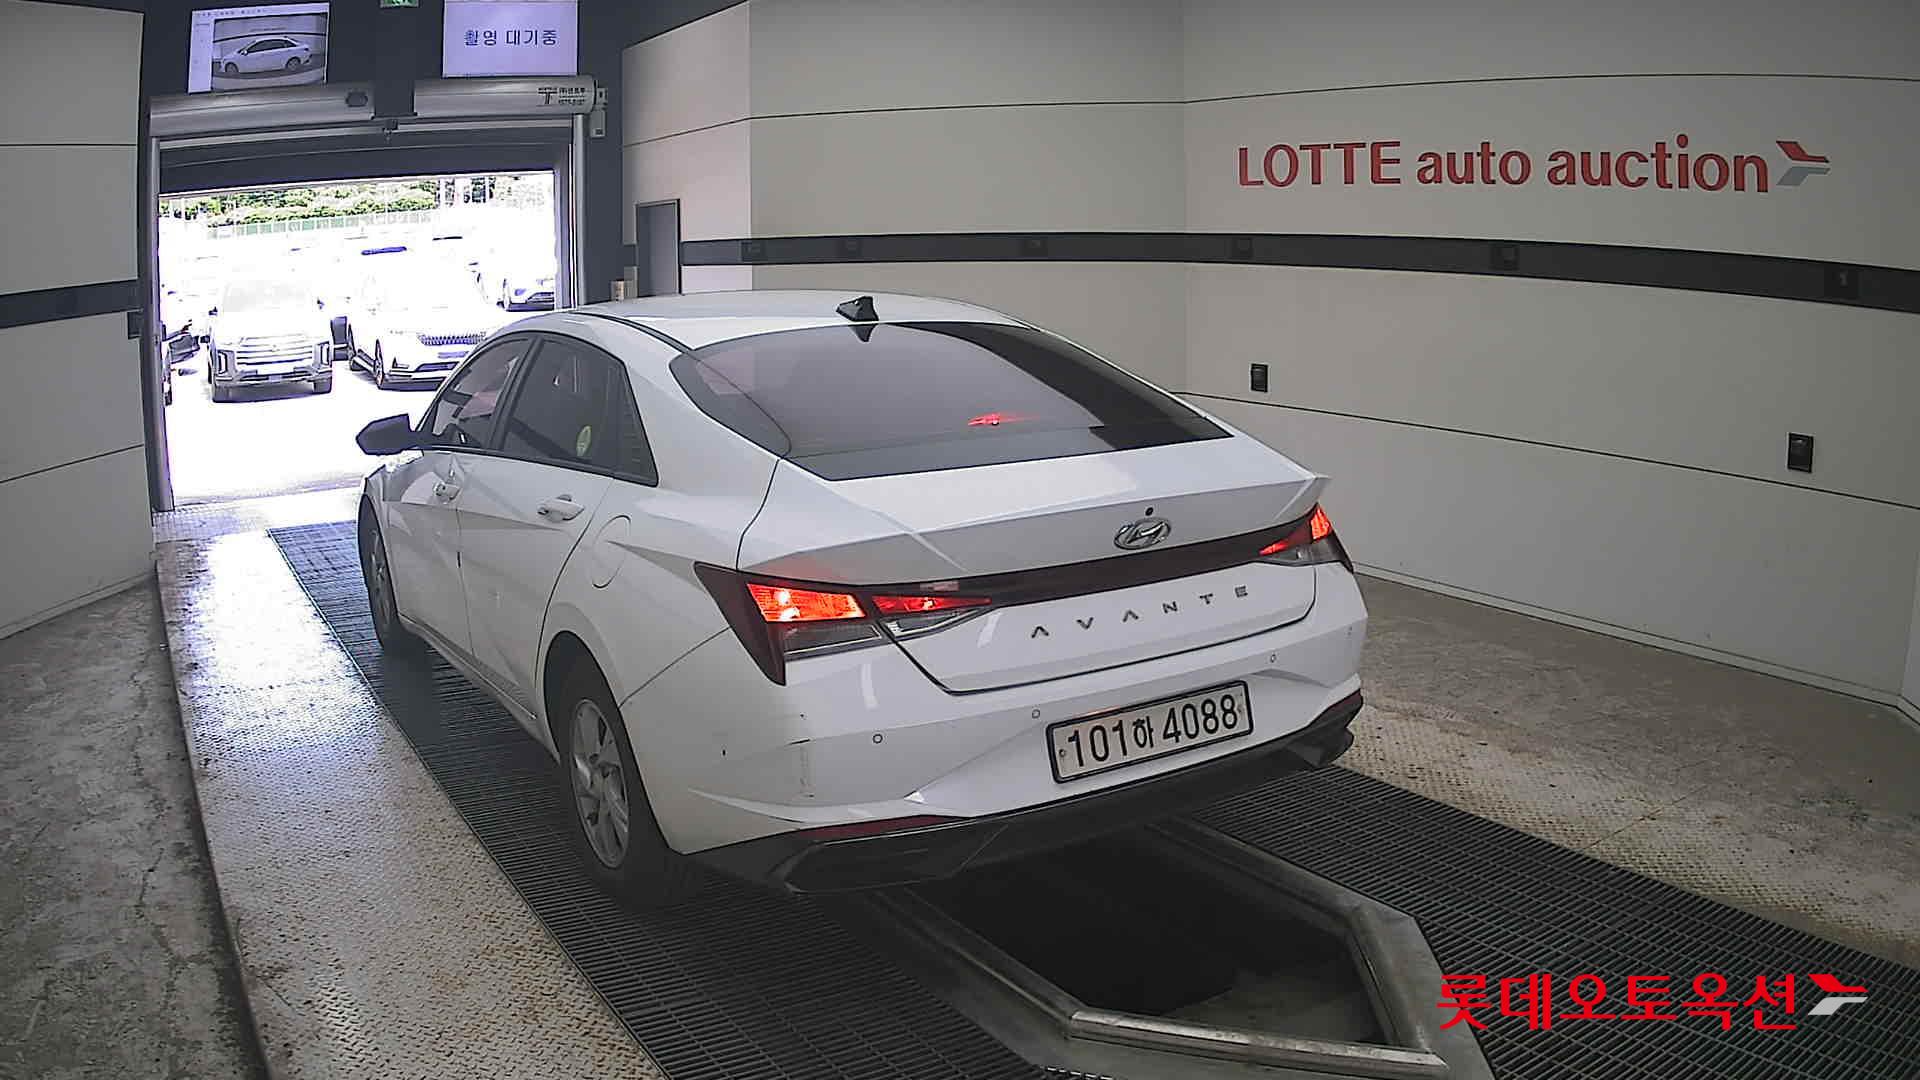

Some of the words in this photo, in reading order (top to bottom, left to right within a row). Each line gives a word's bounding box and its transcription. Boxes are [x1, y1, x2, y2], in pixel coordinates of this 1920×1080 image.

[506, 29, 558, 46] 대기중
[1238, 140, 1401, 187] LOTTE
[1416, 141, 1531, 184] auto
[1547, 134, 1768, 193] auction
[1031, 585, 1249, 639] AVANTE
